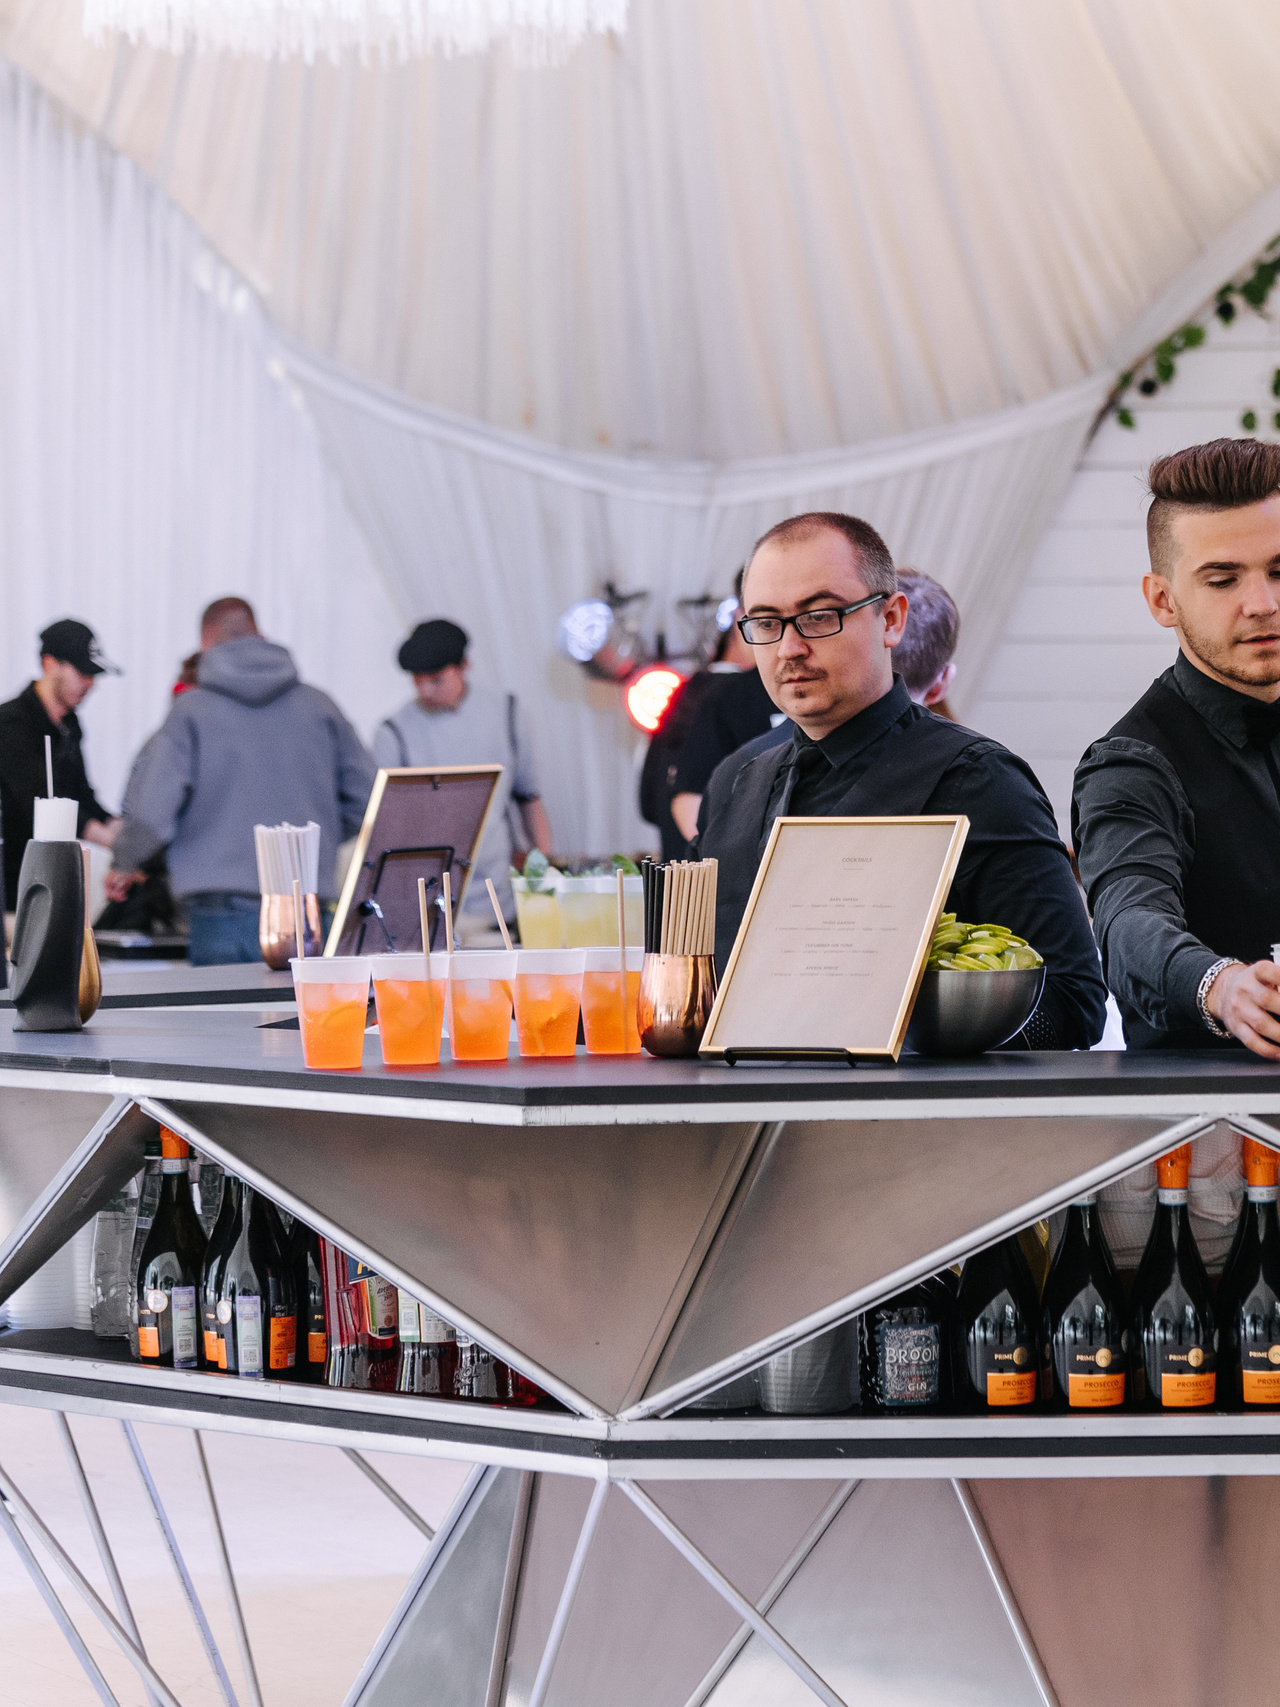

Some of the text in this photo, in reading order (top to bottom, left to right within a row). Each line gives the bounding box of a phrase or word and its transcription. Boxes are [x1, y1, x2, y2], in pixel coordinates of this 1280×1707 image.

[994, 1353, 1013, 1361] PRIME
[1168, 1354, 1187, 1362] PRIME
[1249, 1350, 1268, 1359] PRIME
[908, 1382, 927, 1391] GIN
[1084, 1379, 1120, 1388] PROSECCO
[1177, 1379, 1211, 1388] PROSECCO
